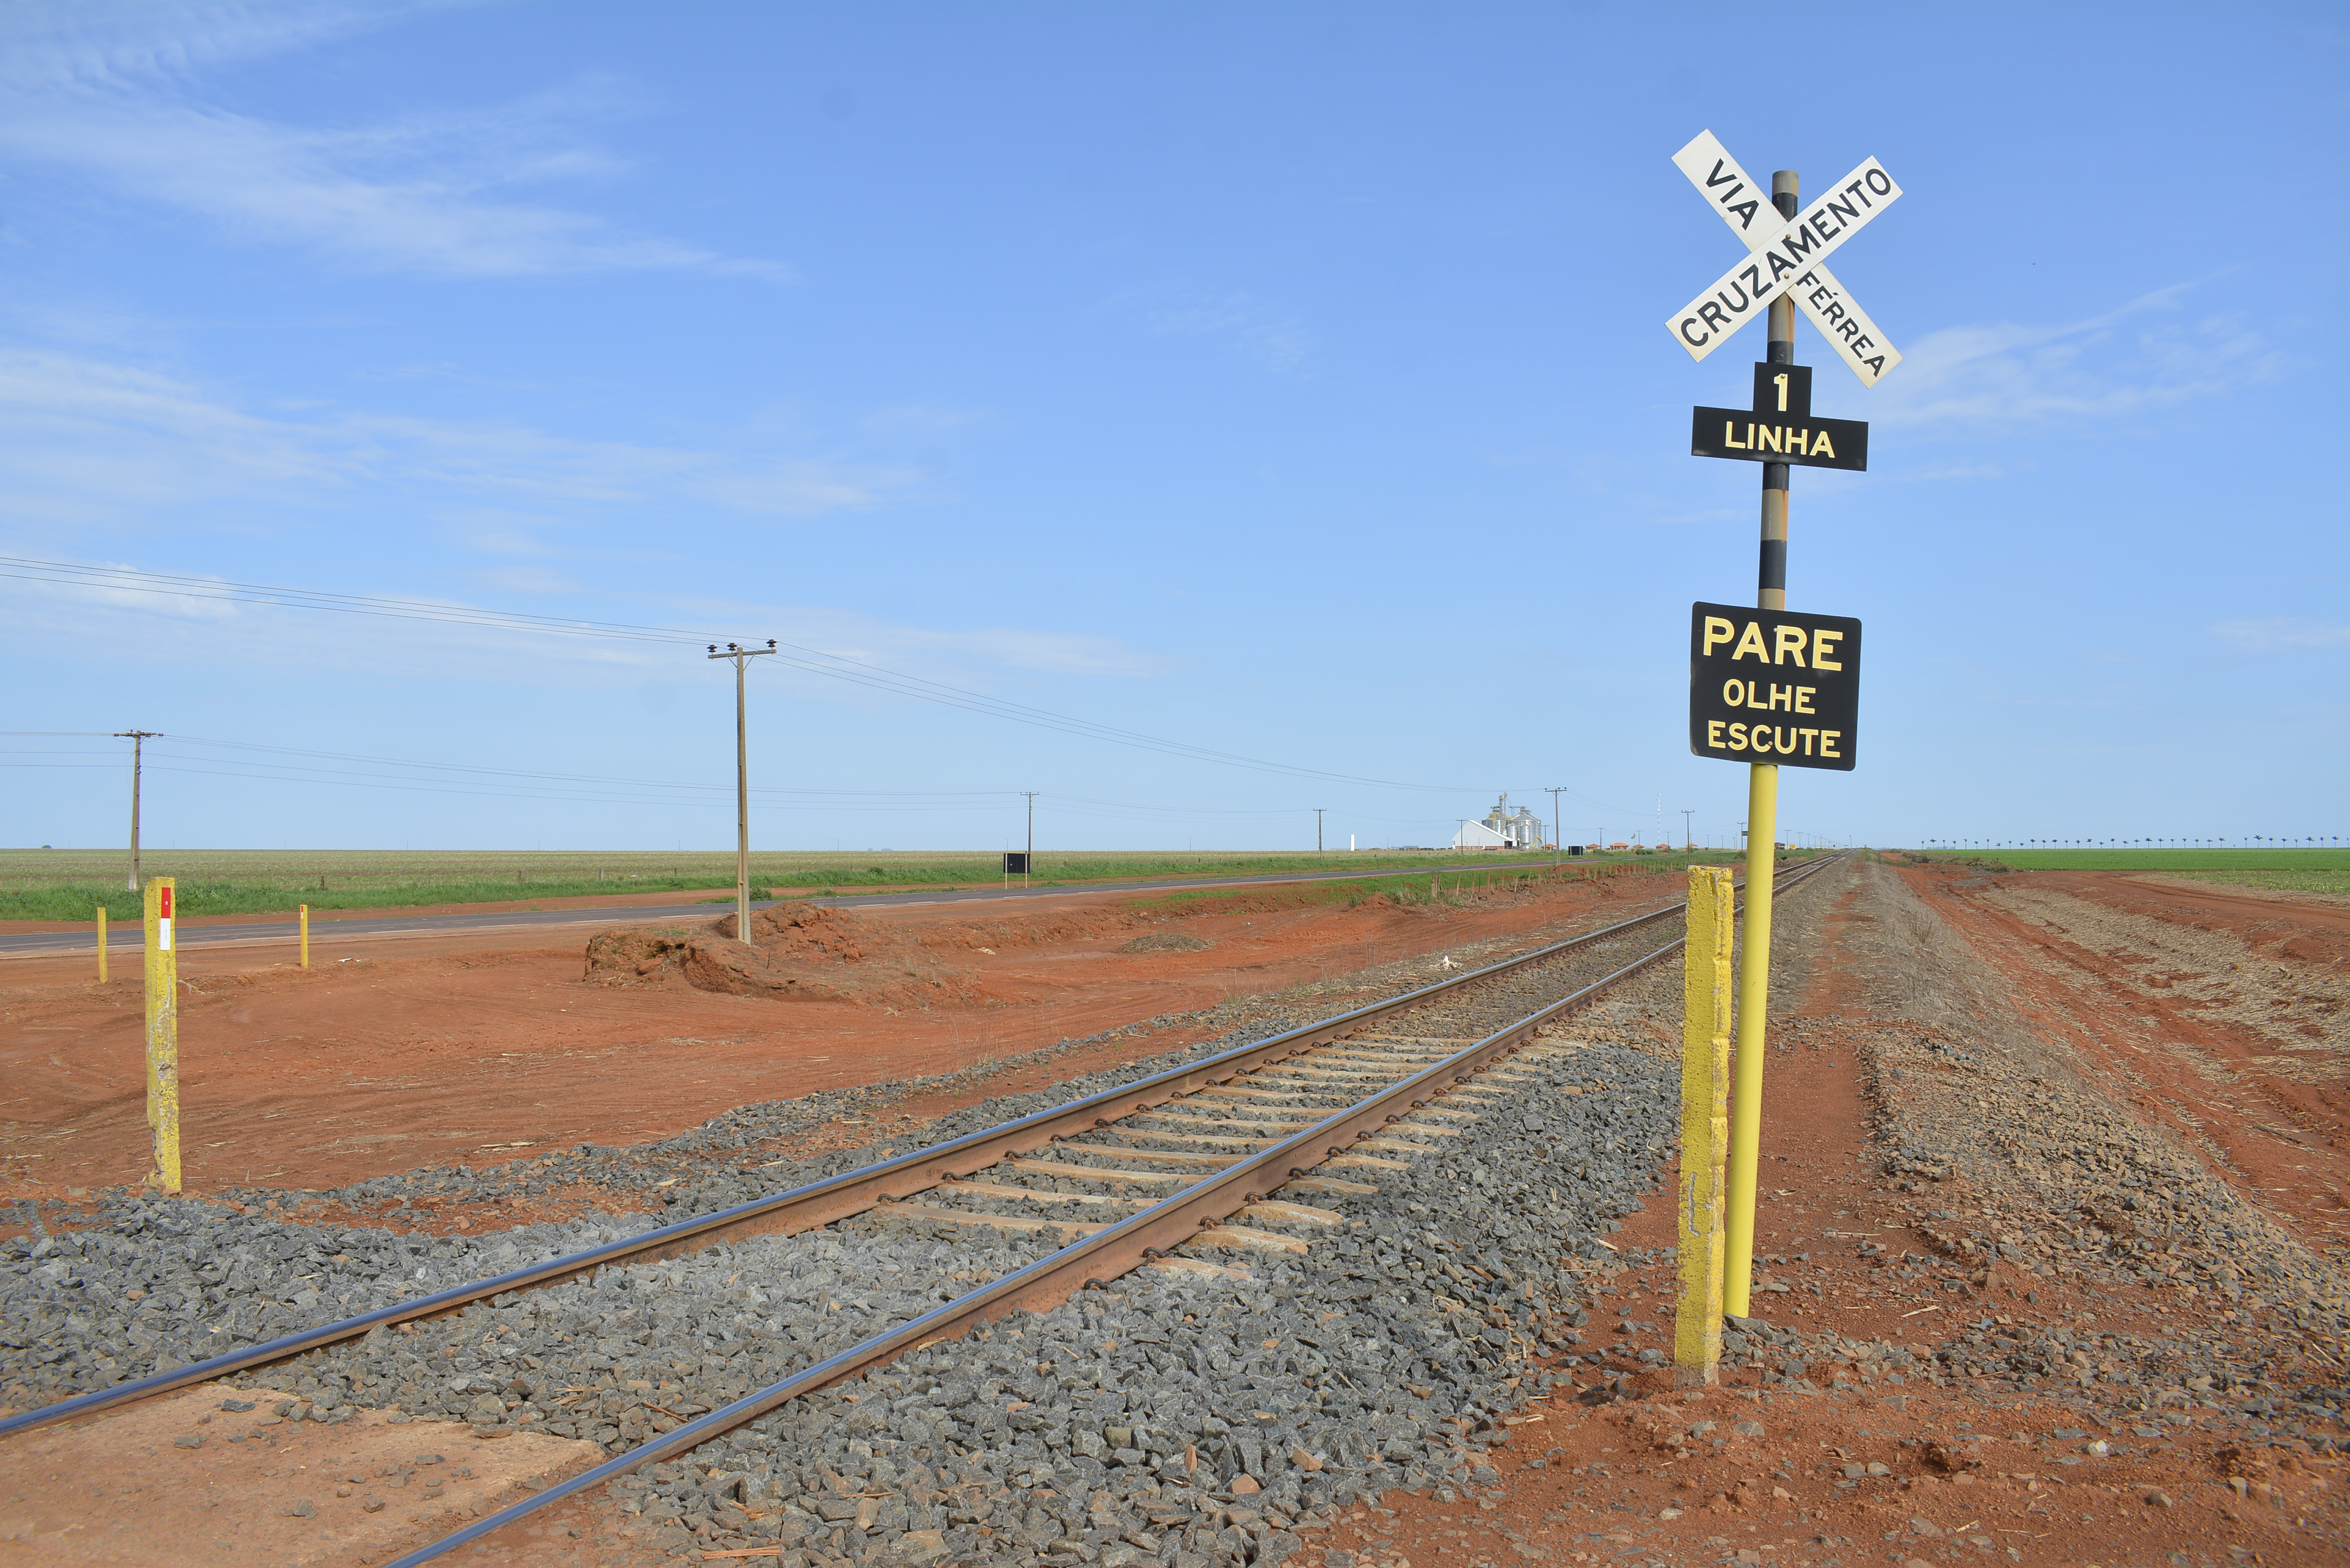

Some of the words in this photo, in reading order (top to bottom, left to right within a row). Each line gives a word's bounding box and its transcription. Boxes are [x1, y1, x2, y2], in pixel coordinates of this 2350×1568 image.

[1680, 168, 1891, 347] CRUZAMENTO
[1706, 158, 1759, 230] VIA
[1796, 270, 1885, 377] FÉRREA
[1774, 373, 1788, 411] 1
[1725, 421, 1835, 458] LINHA
[1703, 616, 1843, 671] PARE
[1723, 679, 1816, 714] OLHE
[1708, 720, 1840, 757] ESCUTE
